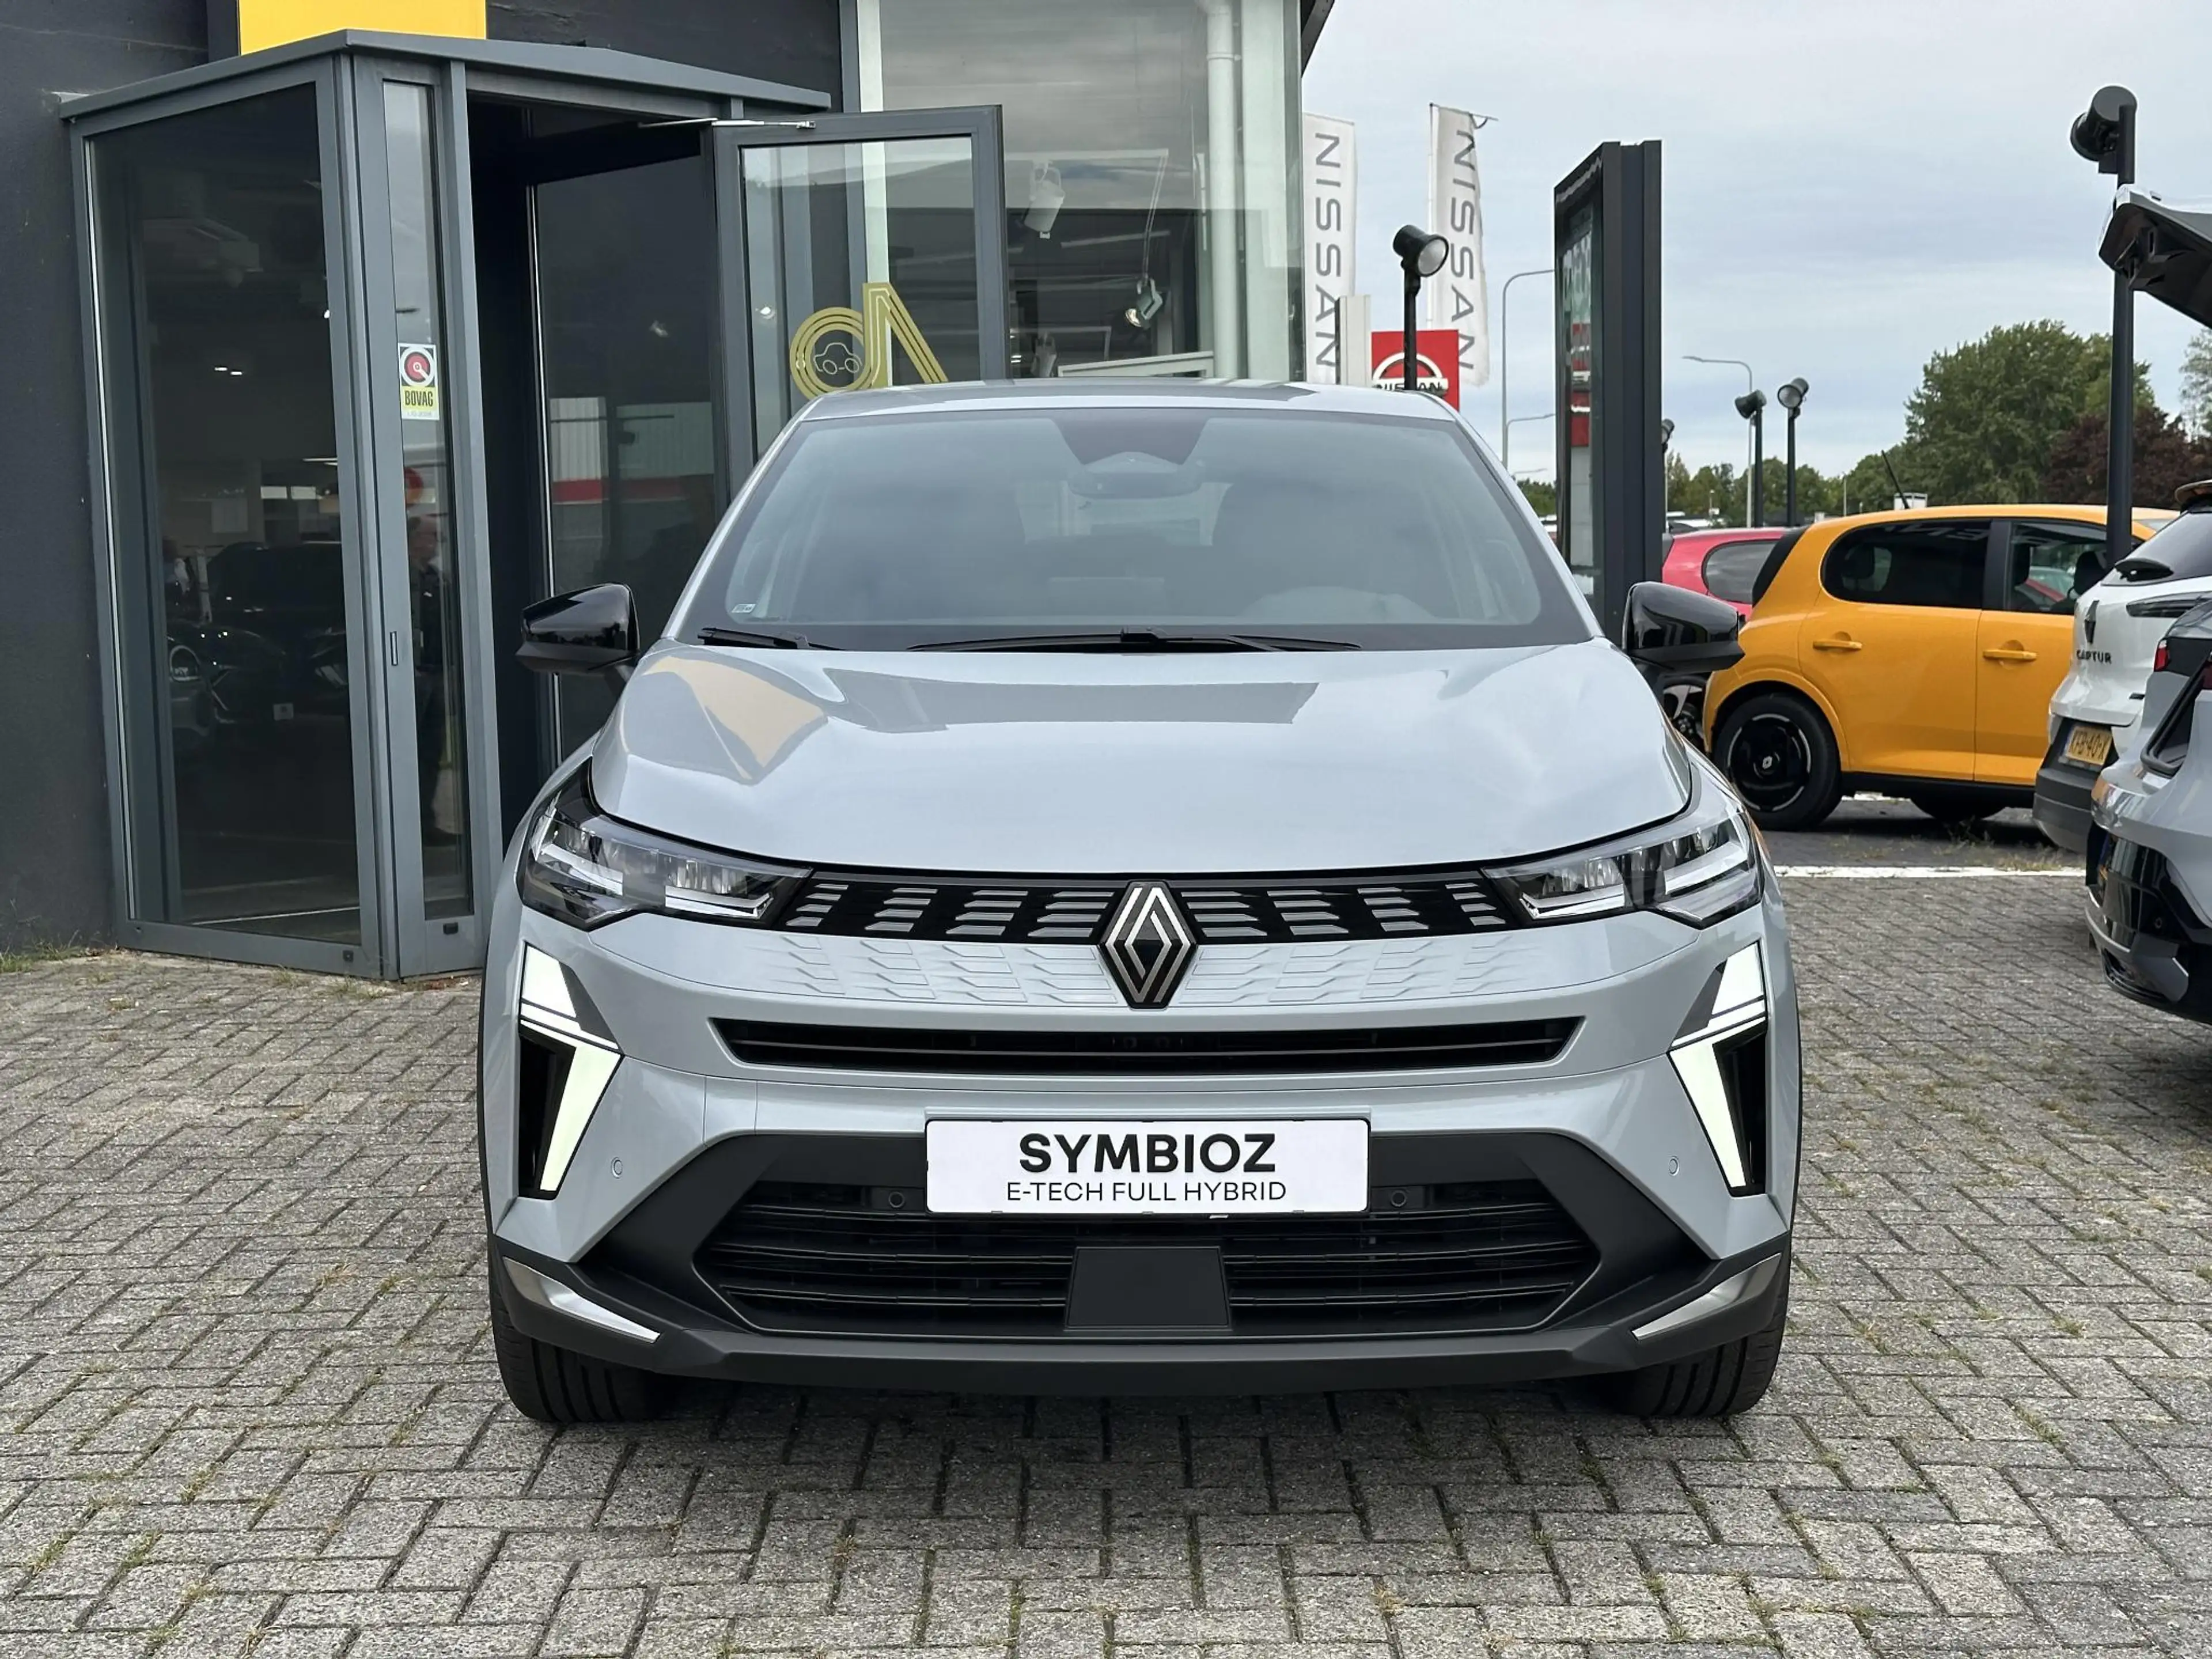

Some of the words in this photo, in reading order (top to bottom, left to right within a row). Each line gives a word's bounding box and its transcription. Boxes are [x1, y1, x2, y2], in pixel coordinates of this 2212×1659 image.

[1315, 132, 1341, 368] NISSAN
[1450, 130, 1476, 370] NISSAN
[404, 390, 433, 407] BOVAG
[2076, 649, 2112, 664] CAPTUR
[1019, 1133, 1276, 1173] SYMBIOZ
[1007, 1182, 1103, 1201] E-TECH
[1112, 1182, 1176, 1201] FULL
[1184, 1181, 1286, 1200] HYBRID
